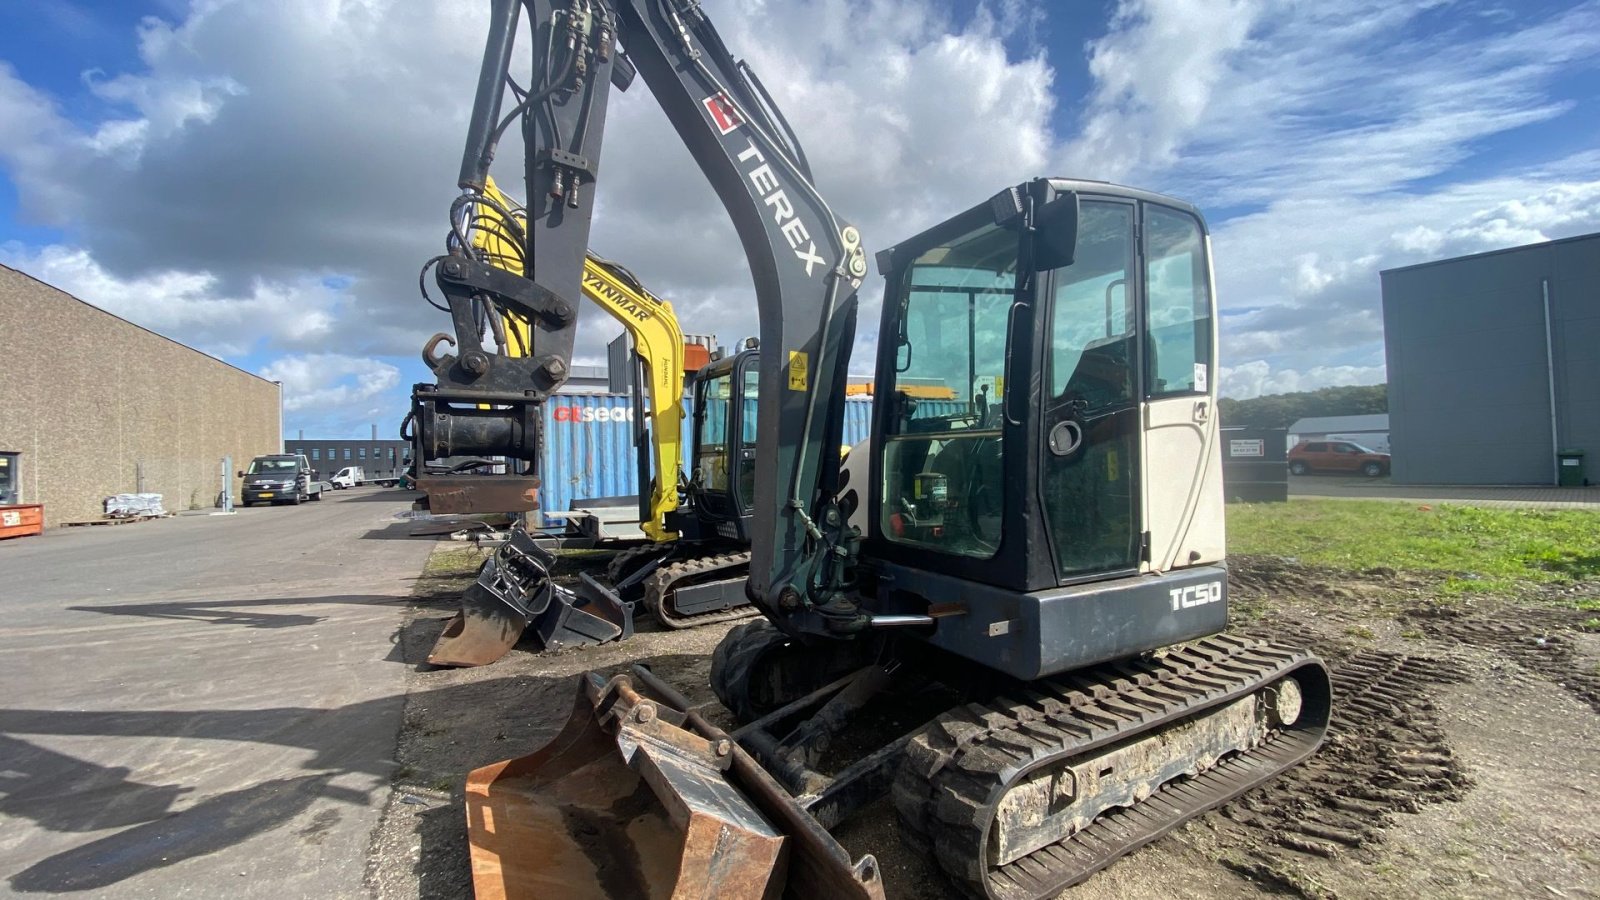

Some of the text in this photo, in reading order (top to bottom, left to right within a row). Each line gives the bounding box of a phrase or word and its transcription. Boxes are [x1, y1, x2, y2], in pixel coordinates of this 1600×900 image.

[737, 135, 826, 278] TEREX
[583, 271, 649, 322] YANMAR
[1169, 581, 1222, 611] TC50
